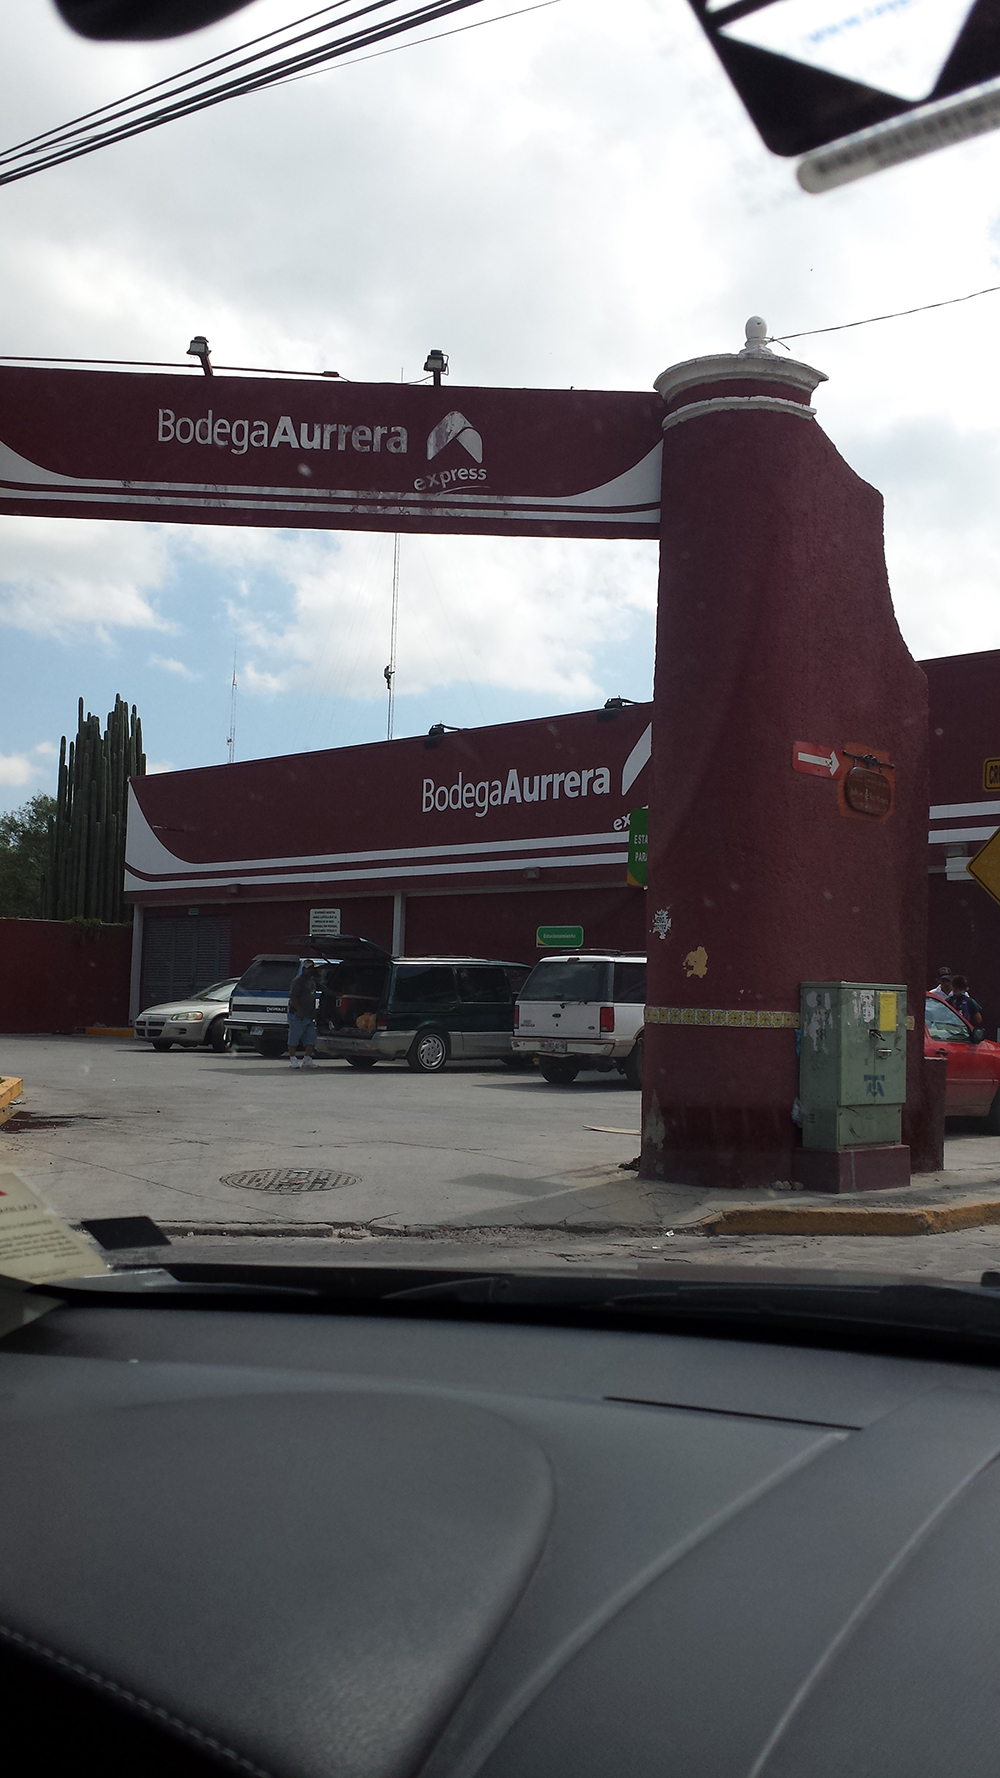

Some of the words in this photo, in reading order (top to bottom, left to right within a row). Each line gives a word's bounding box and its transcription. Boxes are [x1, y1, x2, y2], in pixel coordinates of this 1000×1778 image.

[157, 408, 408, 455] BodegaAurrera
[413, 468, 487, 491] express
[990, 765, 1000, 784] CR
[422, 766, 611, 818] BodegaAurrera
[613, 813, 630, 831] ex
